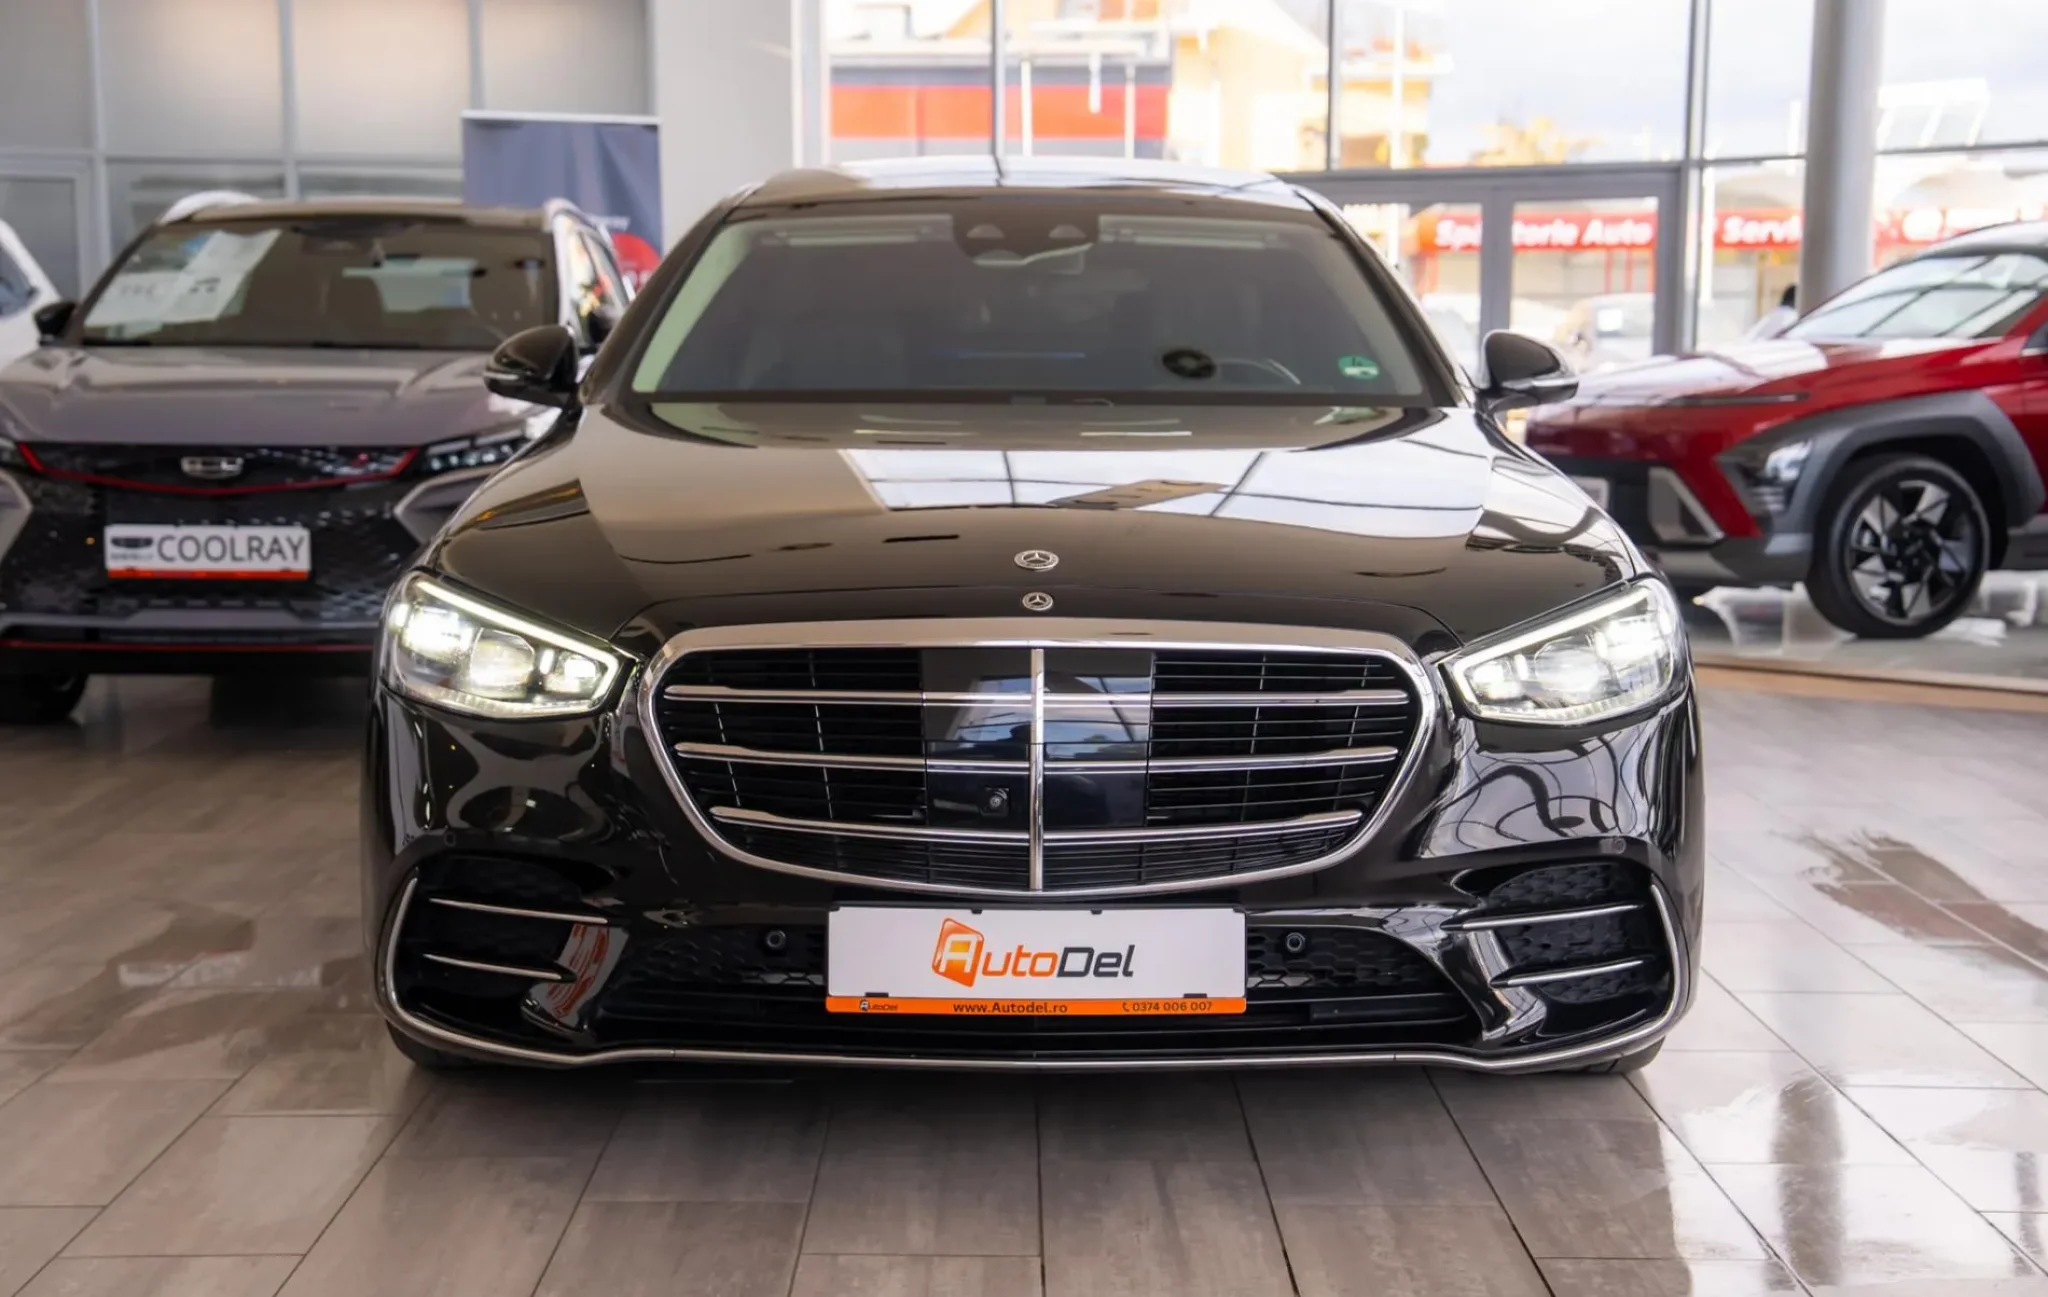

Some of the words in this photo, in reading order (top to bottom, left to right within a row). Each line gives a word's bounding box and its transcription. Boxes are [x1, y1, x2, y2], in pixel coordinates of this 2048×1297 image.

[1581, 218, 1654, 246] Auto
[157, 534, 304, 562] COOLRAY
[936, 928, 1136, 979] AutoDel
[953, 1002, 1068, 1014] www.Autodel.ro
[1132, 1002, 1160, 1012] 0374
[1163, 1001, 1187, 1012] 006
[1190, 1001, 1212, 1011] 007
